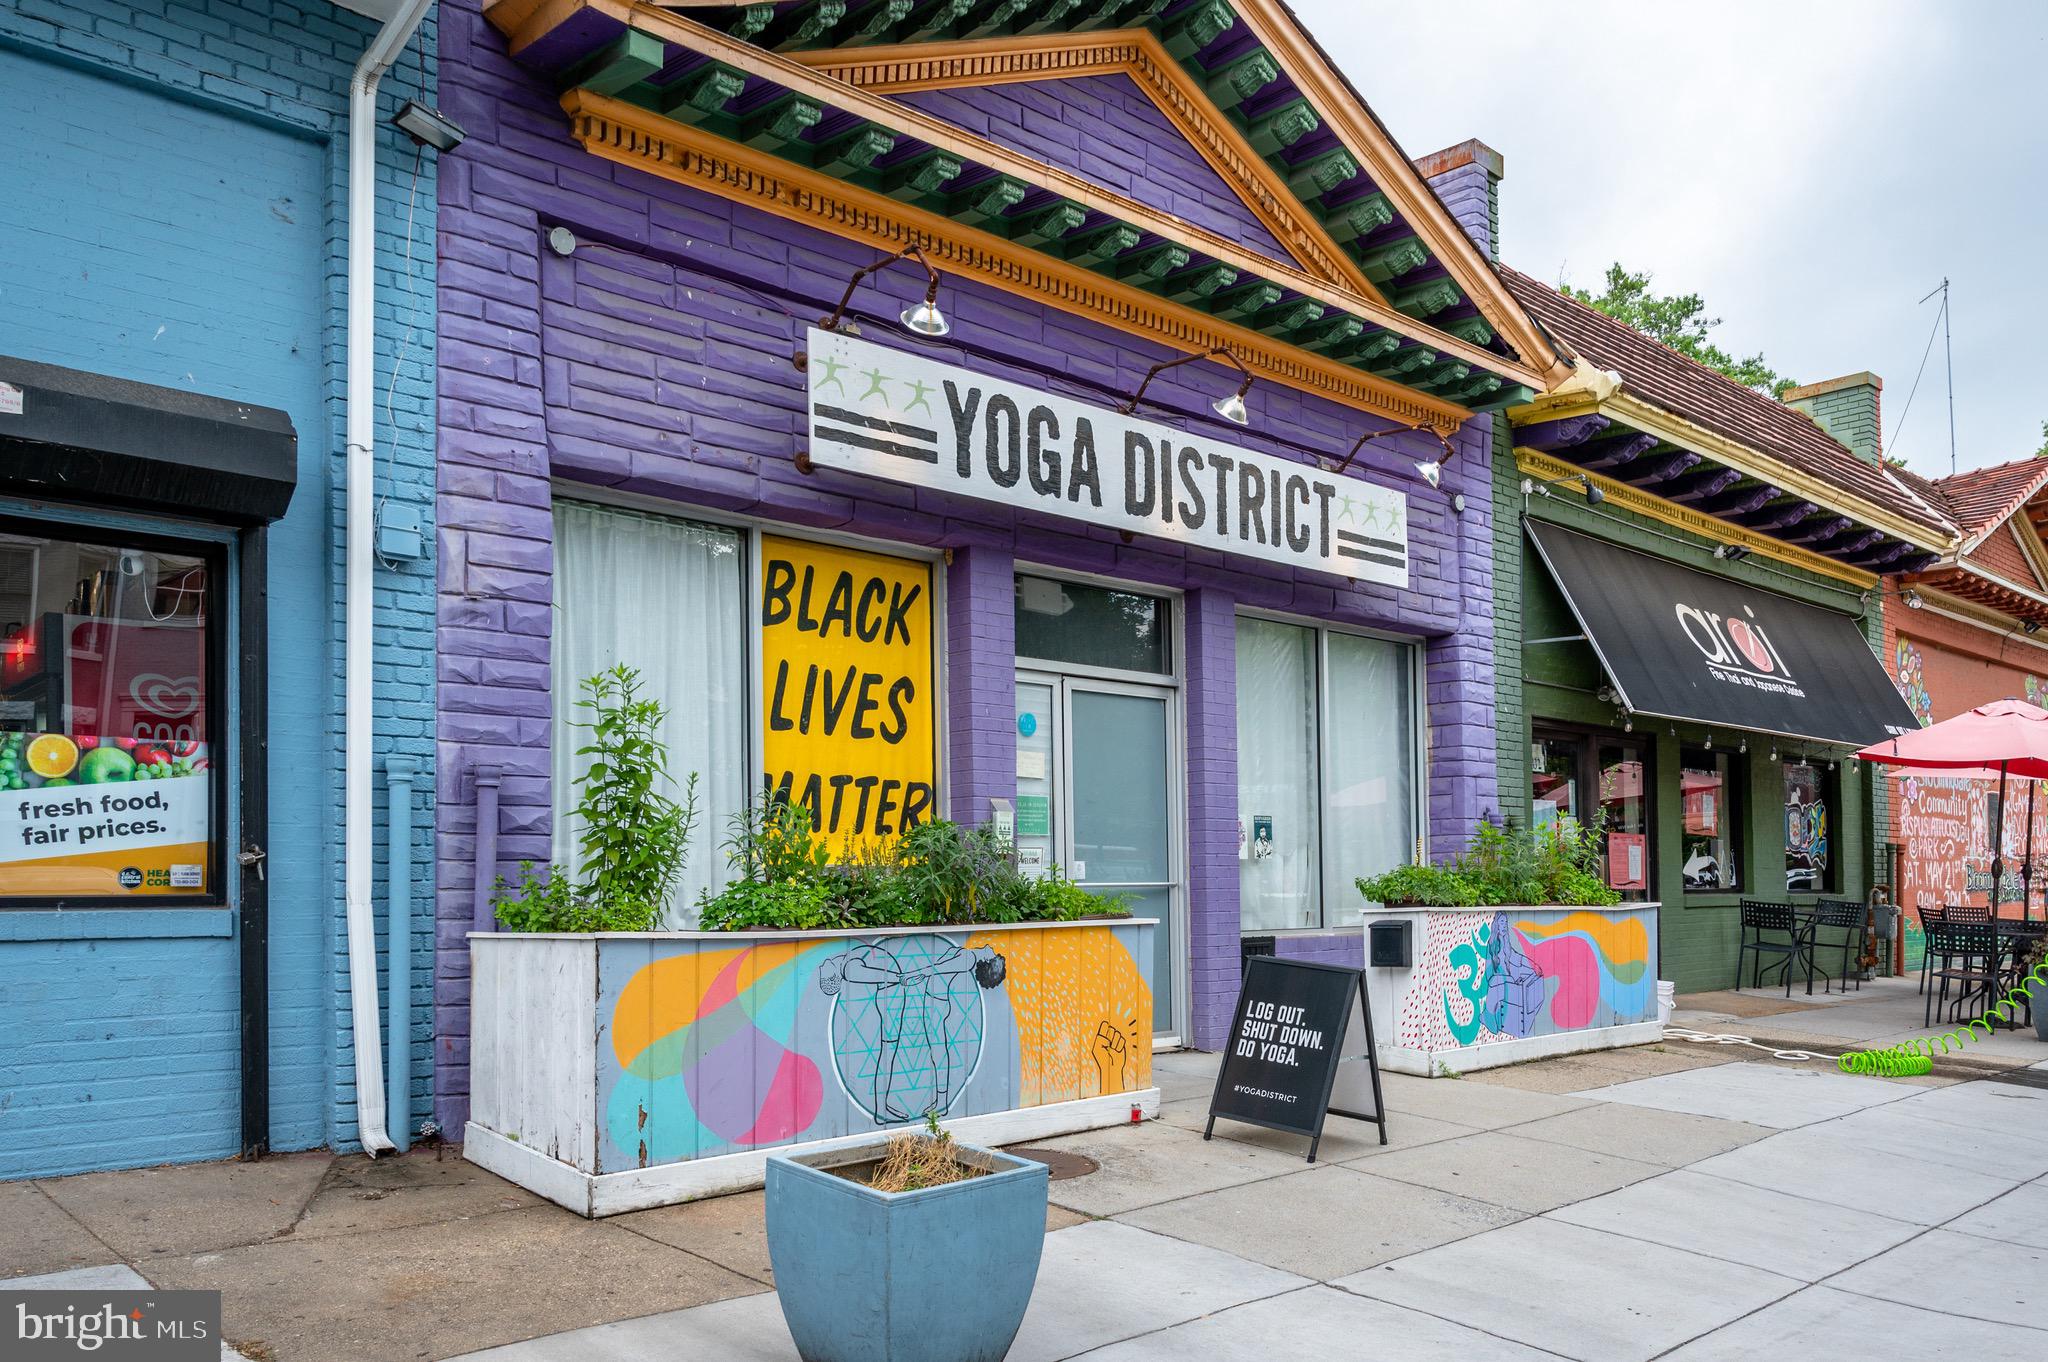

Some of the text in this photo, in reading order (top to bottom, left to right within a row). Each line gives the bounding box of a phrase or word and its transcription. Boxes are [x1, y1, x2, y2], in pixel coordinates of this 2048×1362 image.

[942, 379, 1336, 558] YOGA DISTRICT
[762, 559, 922, 646] BLACK
[1675, 603, 1791, 678] aroi
[770, 659, 915, 744] LIVES
[18, 790, 169, 820] fresh food,
[21, 818, 167, 846] fair prices.
[147, 869, 171, 877] HEA
[147, 878, 171, 887] COR
[1246, 1000, 1305, 1026] LOG OUT.
[1241, 1019, 1323, 1050] SHUT DOWN.
[1236, 1038, 1299, 1067] DO YOGA.
[1234, 1084, 1298, 1103] #YOGADISTRICT
